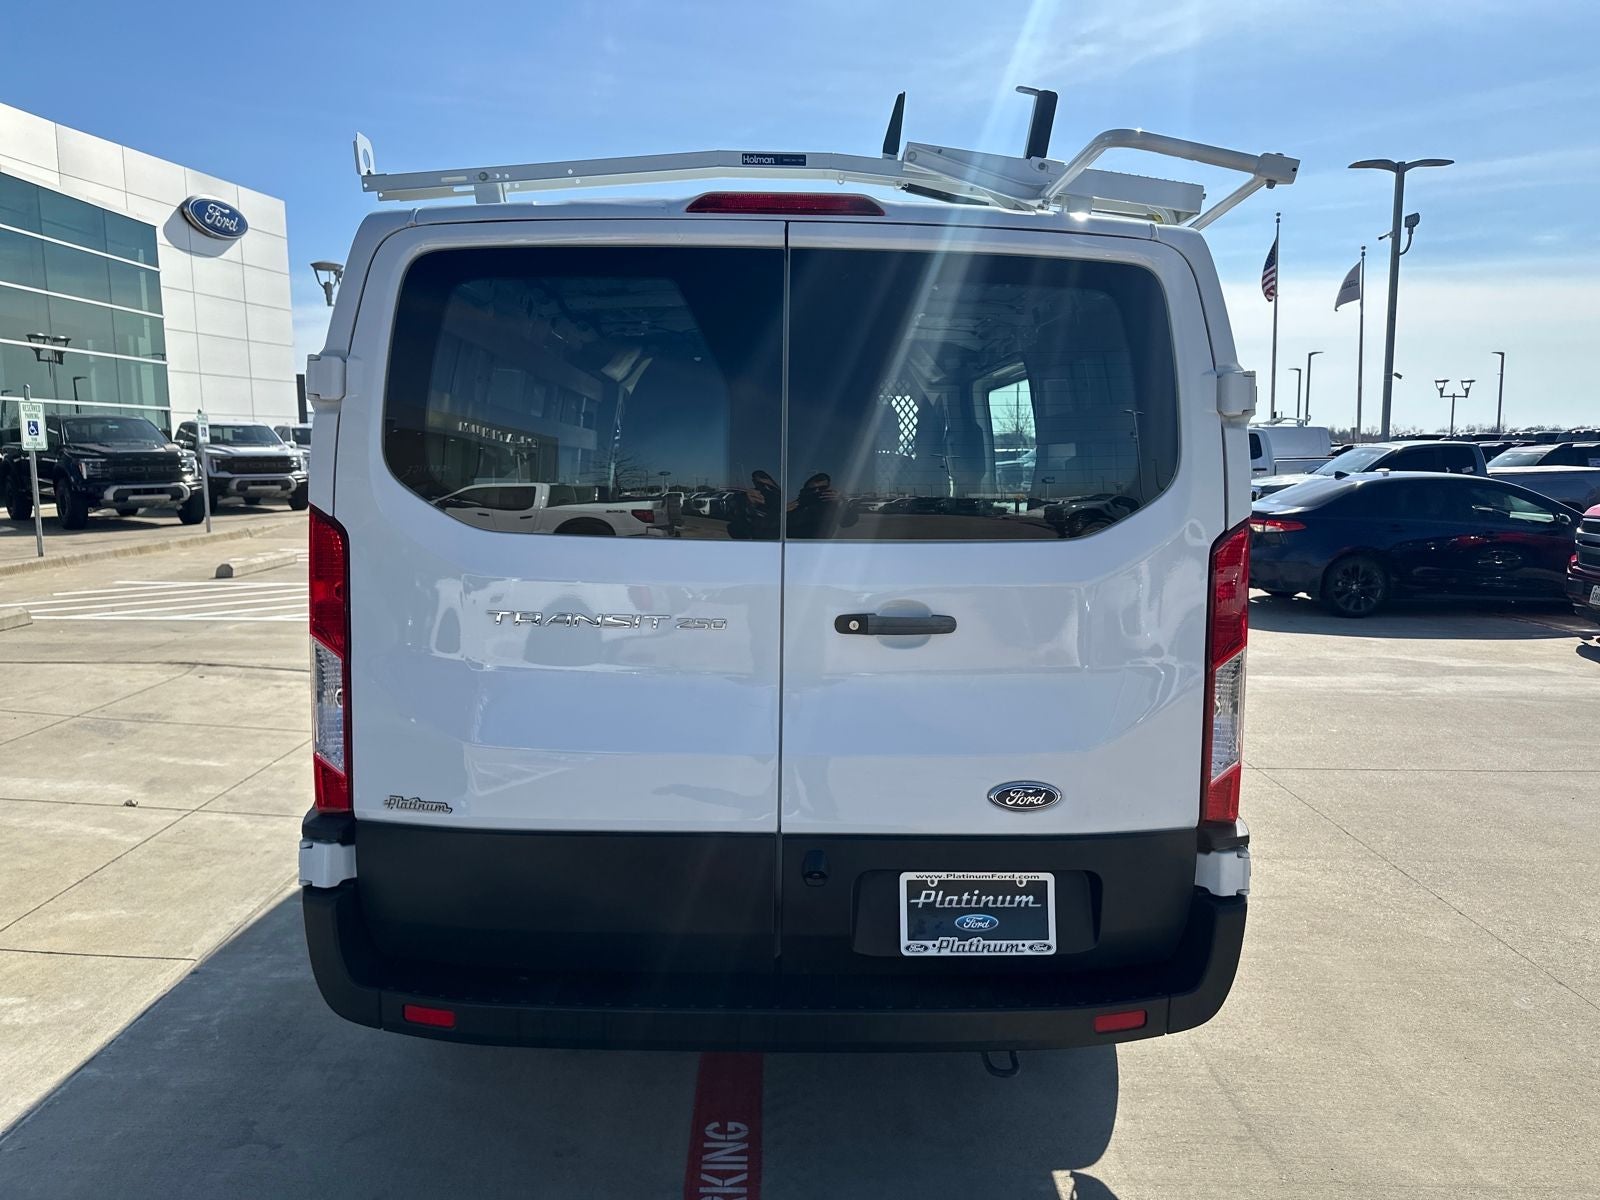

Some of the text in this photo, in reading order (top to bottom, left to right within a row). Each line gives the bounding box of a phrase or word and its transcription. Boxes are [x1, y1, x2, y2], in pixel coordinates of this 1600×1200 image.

[743, 154, 775, 164] Holman
[204, 203, 239, 232] Ford
[487, 610, 727, 630] TRANSIT 250
[384, 795, 453, 814] Platinum
[1006, 788, 1046, 805] Ford
[910, 890, 1042, 908] Platinum
[963, 917, 990, 929] Ford
[936, 938, 1026, 954] Platinum
[698, 1121, 749, 1200] KING
